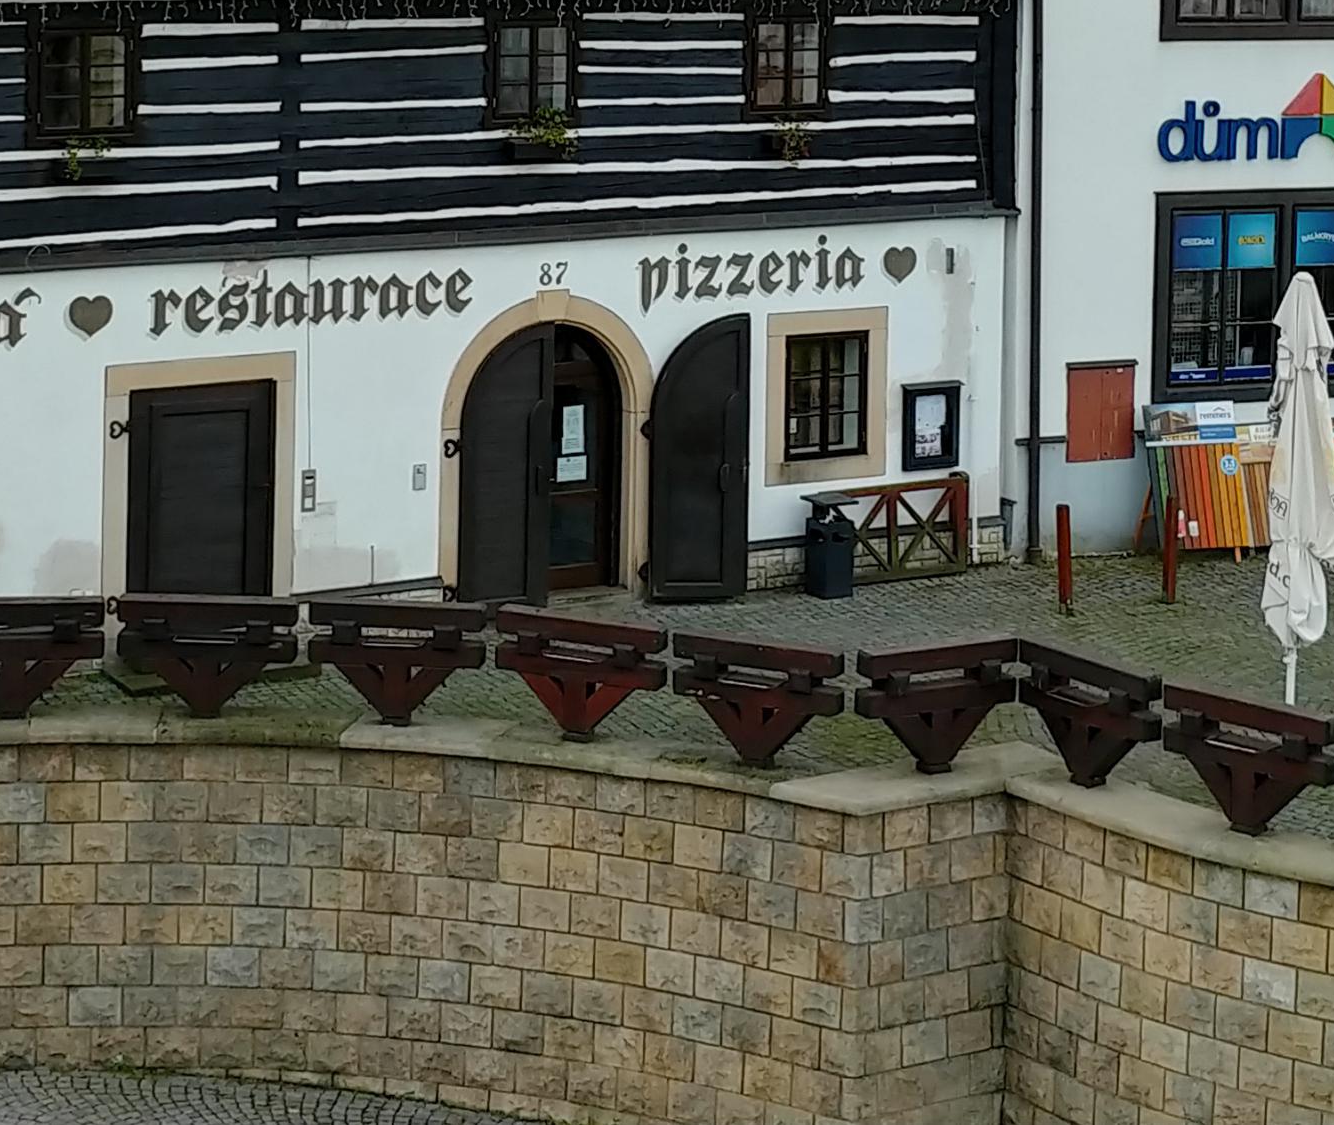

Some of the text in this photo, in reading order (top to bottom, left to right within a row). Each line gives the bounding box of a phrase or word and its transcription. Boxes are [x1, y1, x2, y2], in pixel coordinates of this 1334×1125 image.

[1157, 99, 1280, 163] dům
[147, 266, 474, 339] restaurace
[636, 233, 866, 314] pizzeria
[538, 262, 569, 287] 87
